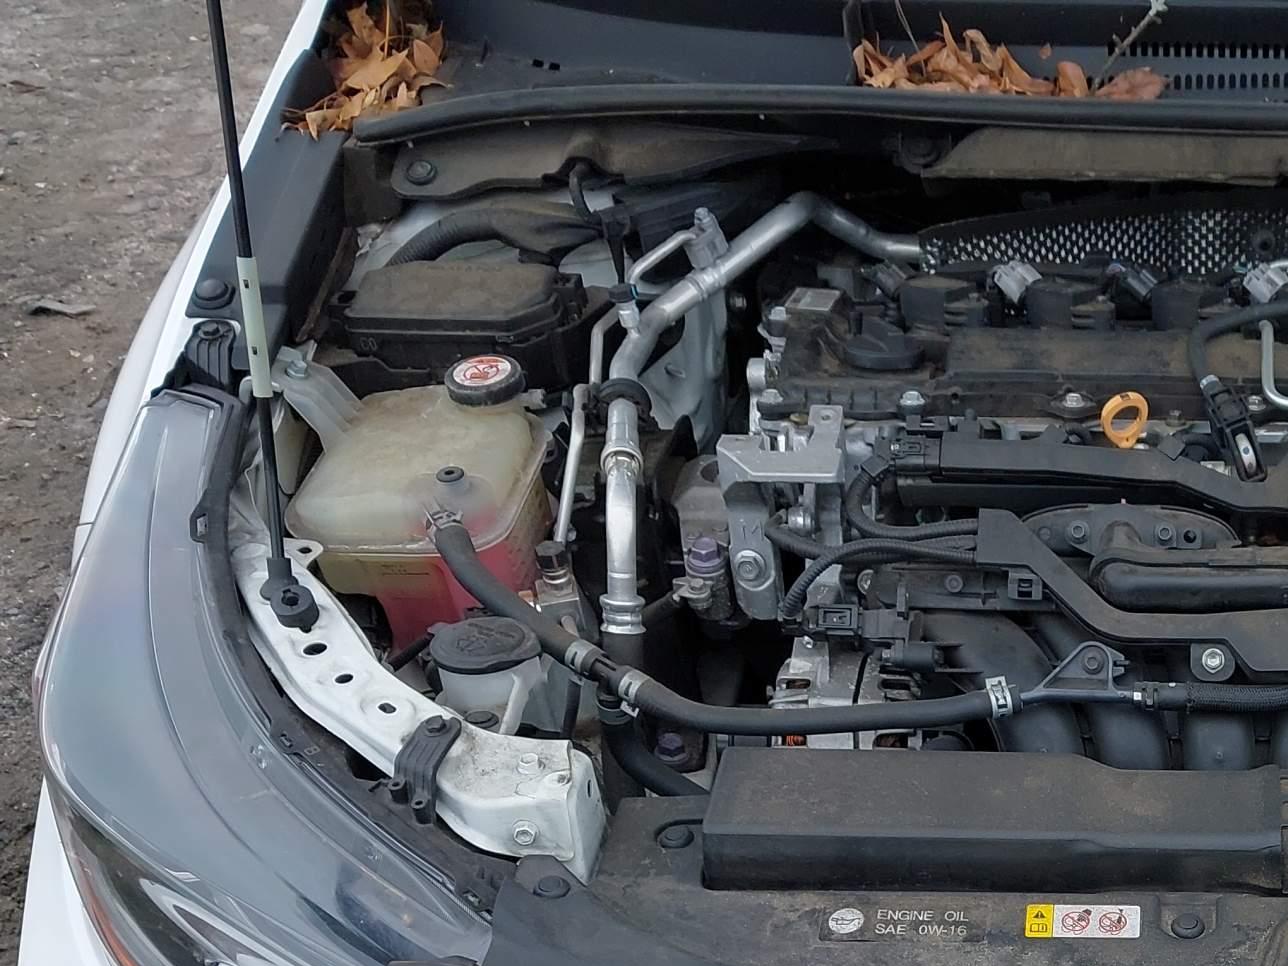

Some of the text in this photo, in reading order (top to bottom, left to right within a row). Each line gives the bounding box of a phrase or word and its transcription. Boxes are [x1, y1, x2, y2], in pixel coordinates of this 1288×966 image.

[876, 909, 969, 922] ENGINE OIL
[874, 923, 967, 937] SAE 0W-16
